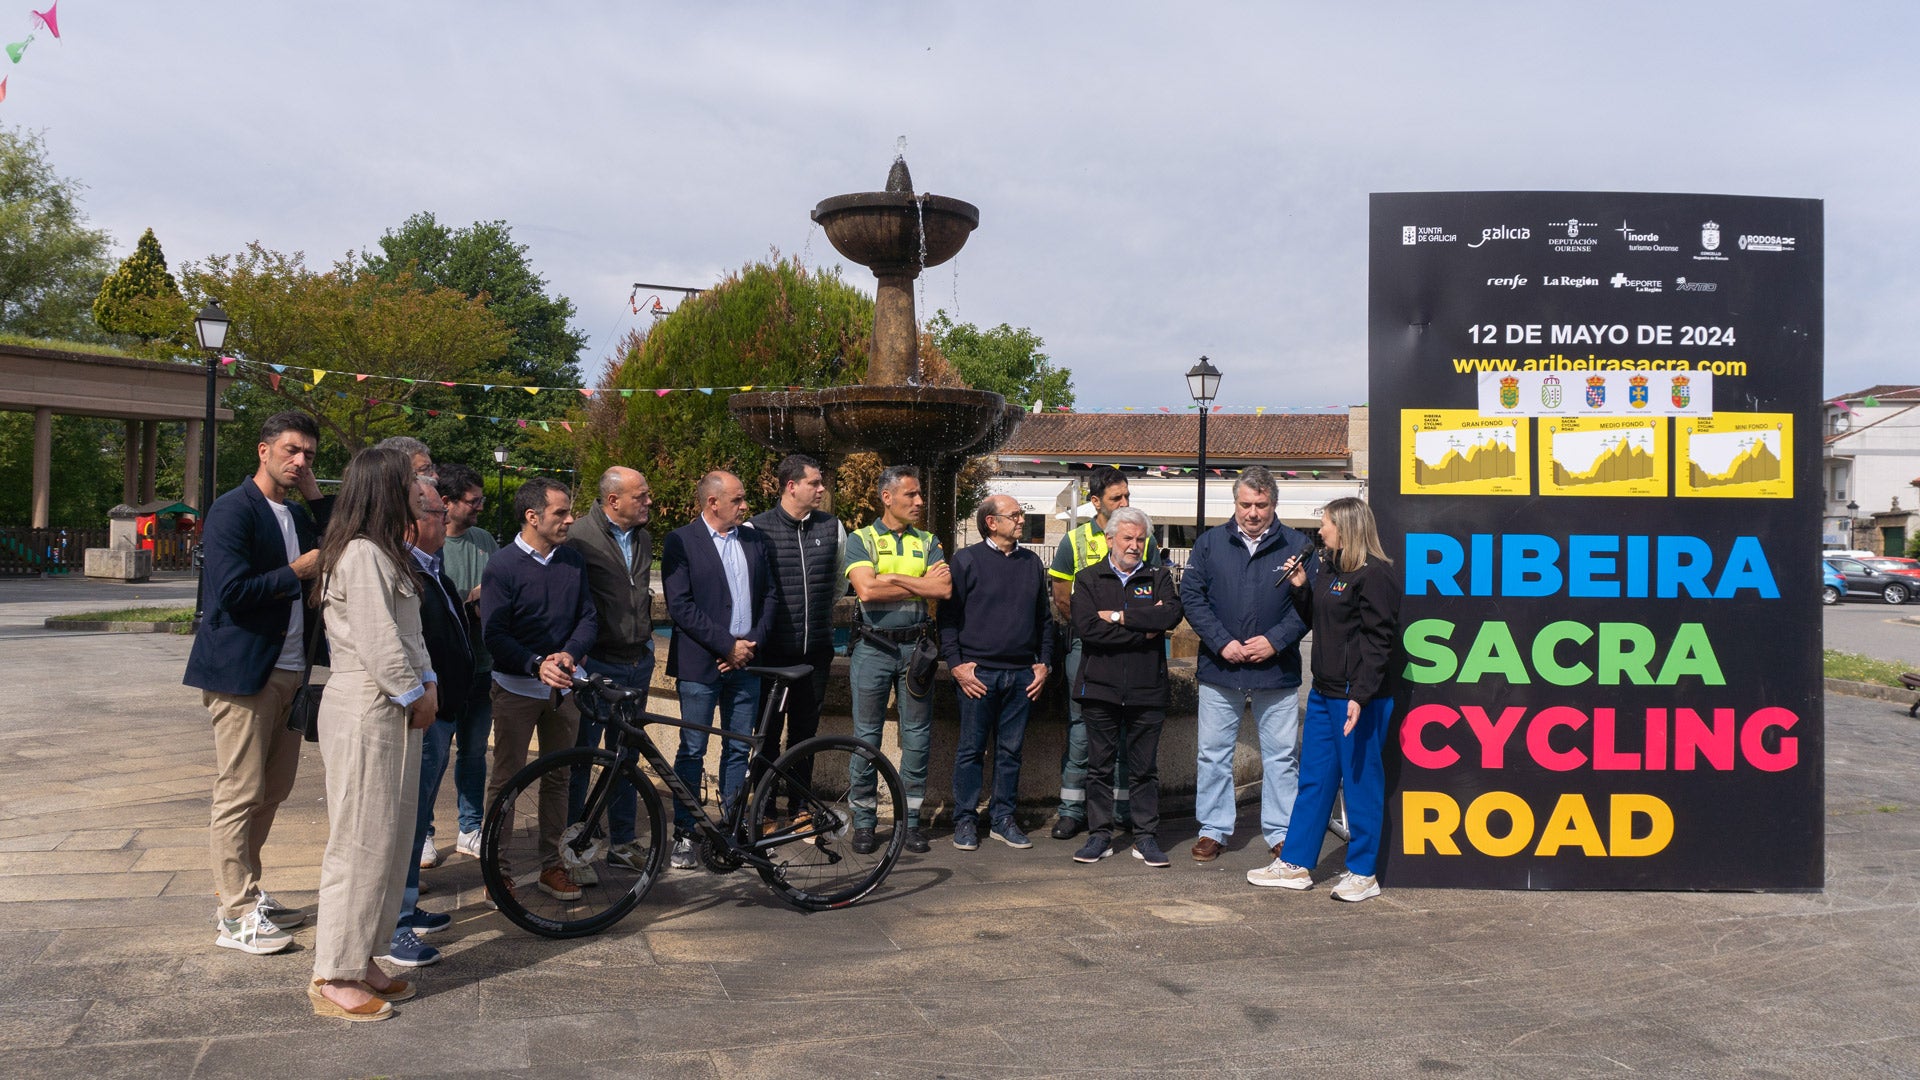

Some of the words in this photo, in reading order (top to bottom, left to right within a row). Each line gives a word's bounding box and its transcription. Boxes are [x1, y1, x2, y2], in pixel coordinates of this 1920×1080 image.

[1418, 226, 1443, 235] XUNTA
[1467, 224, 1531, 248] galicia
[1628, 232, 1660, 242] inorde
[1418, 234, 1427, 242] DE
[1428, 234, 1457, 242] GALICIA
[1548, 237, 1598, 245] DEPUTACIÓN
[1747, 234, 1782, 245] RODOSA
[1628, 244, 1653, 252] turismo
[1653, 244, 1679, 252] Ourense
[1486, 273, 1528, 290] renfe
[1543, 276, 1560, 286] La
[1624, 280, 1662, 288] DEPORTE
[1468, 324, 1497, 344] 12
[1505, 324, 1543, 344] DE
[1550, 324, 1629, 345] MAYO
[1637, 325, 1673, 345] DE
[1679, 326, 1736, 346] 2024
[1452, 354, 1747, 376] www.aribeirasacracom
[1405, 533, 1781, 599] RIBEIRA
[1402, 619, 1727, 687] SACRA
[1400, 703, 1800, 773] CYCLING
[1402, 791, 1675, 858] ROAD
